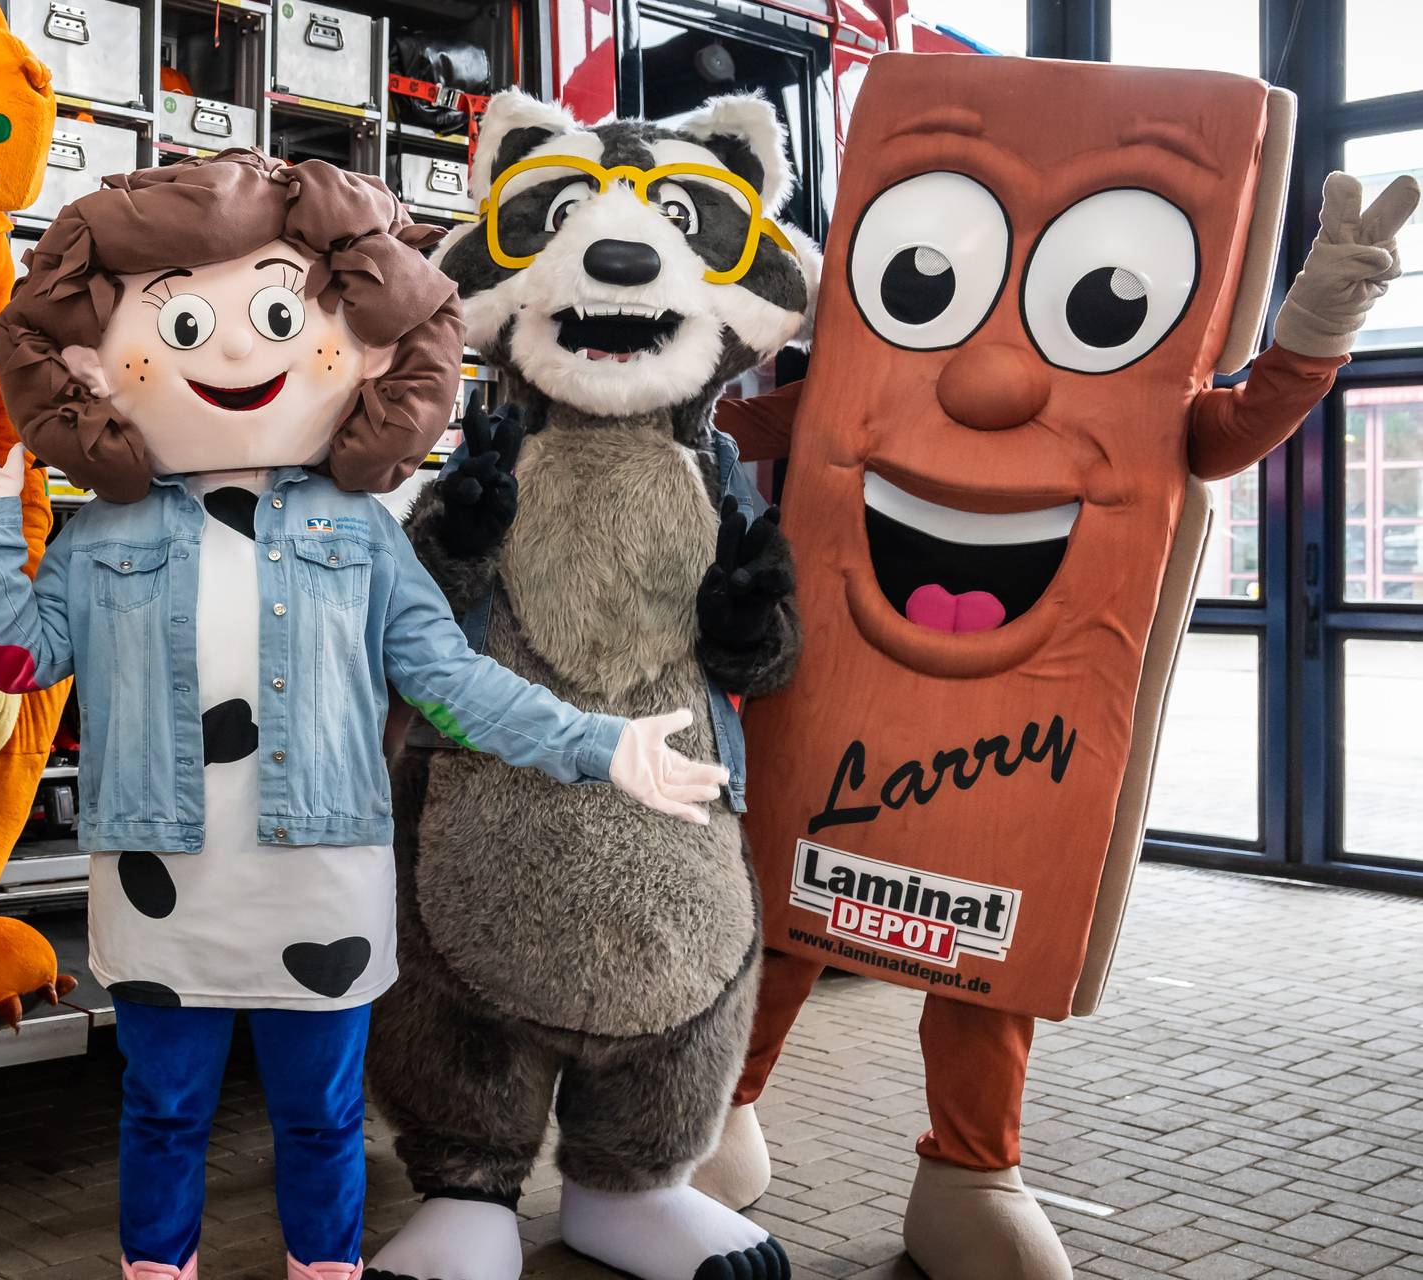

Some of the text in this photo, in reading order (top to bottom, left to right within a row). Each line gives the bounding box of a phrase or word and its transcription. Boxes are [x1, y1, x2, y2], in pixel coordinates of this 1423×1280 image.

[808, 715, 1077, 835] Larry
[803, 848, 1005, 933] Laminat
[836, 902, 950, 954] DEPOT
[788, 926, 992, 995] www.laminatdepot.de
